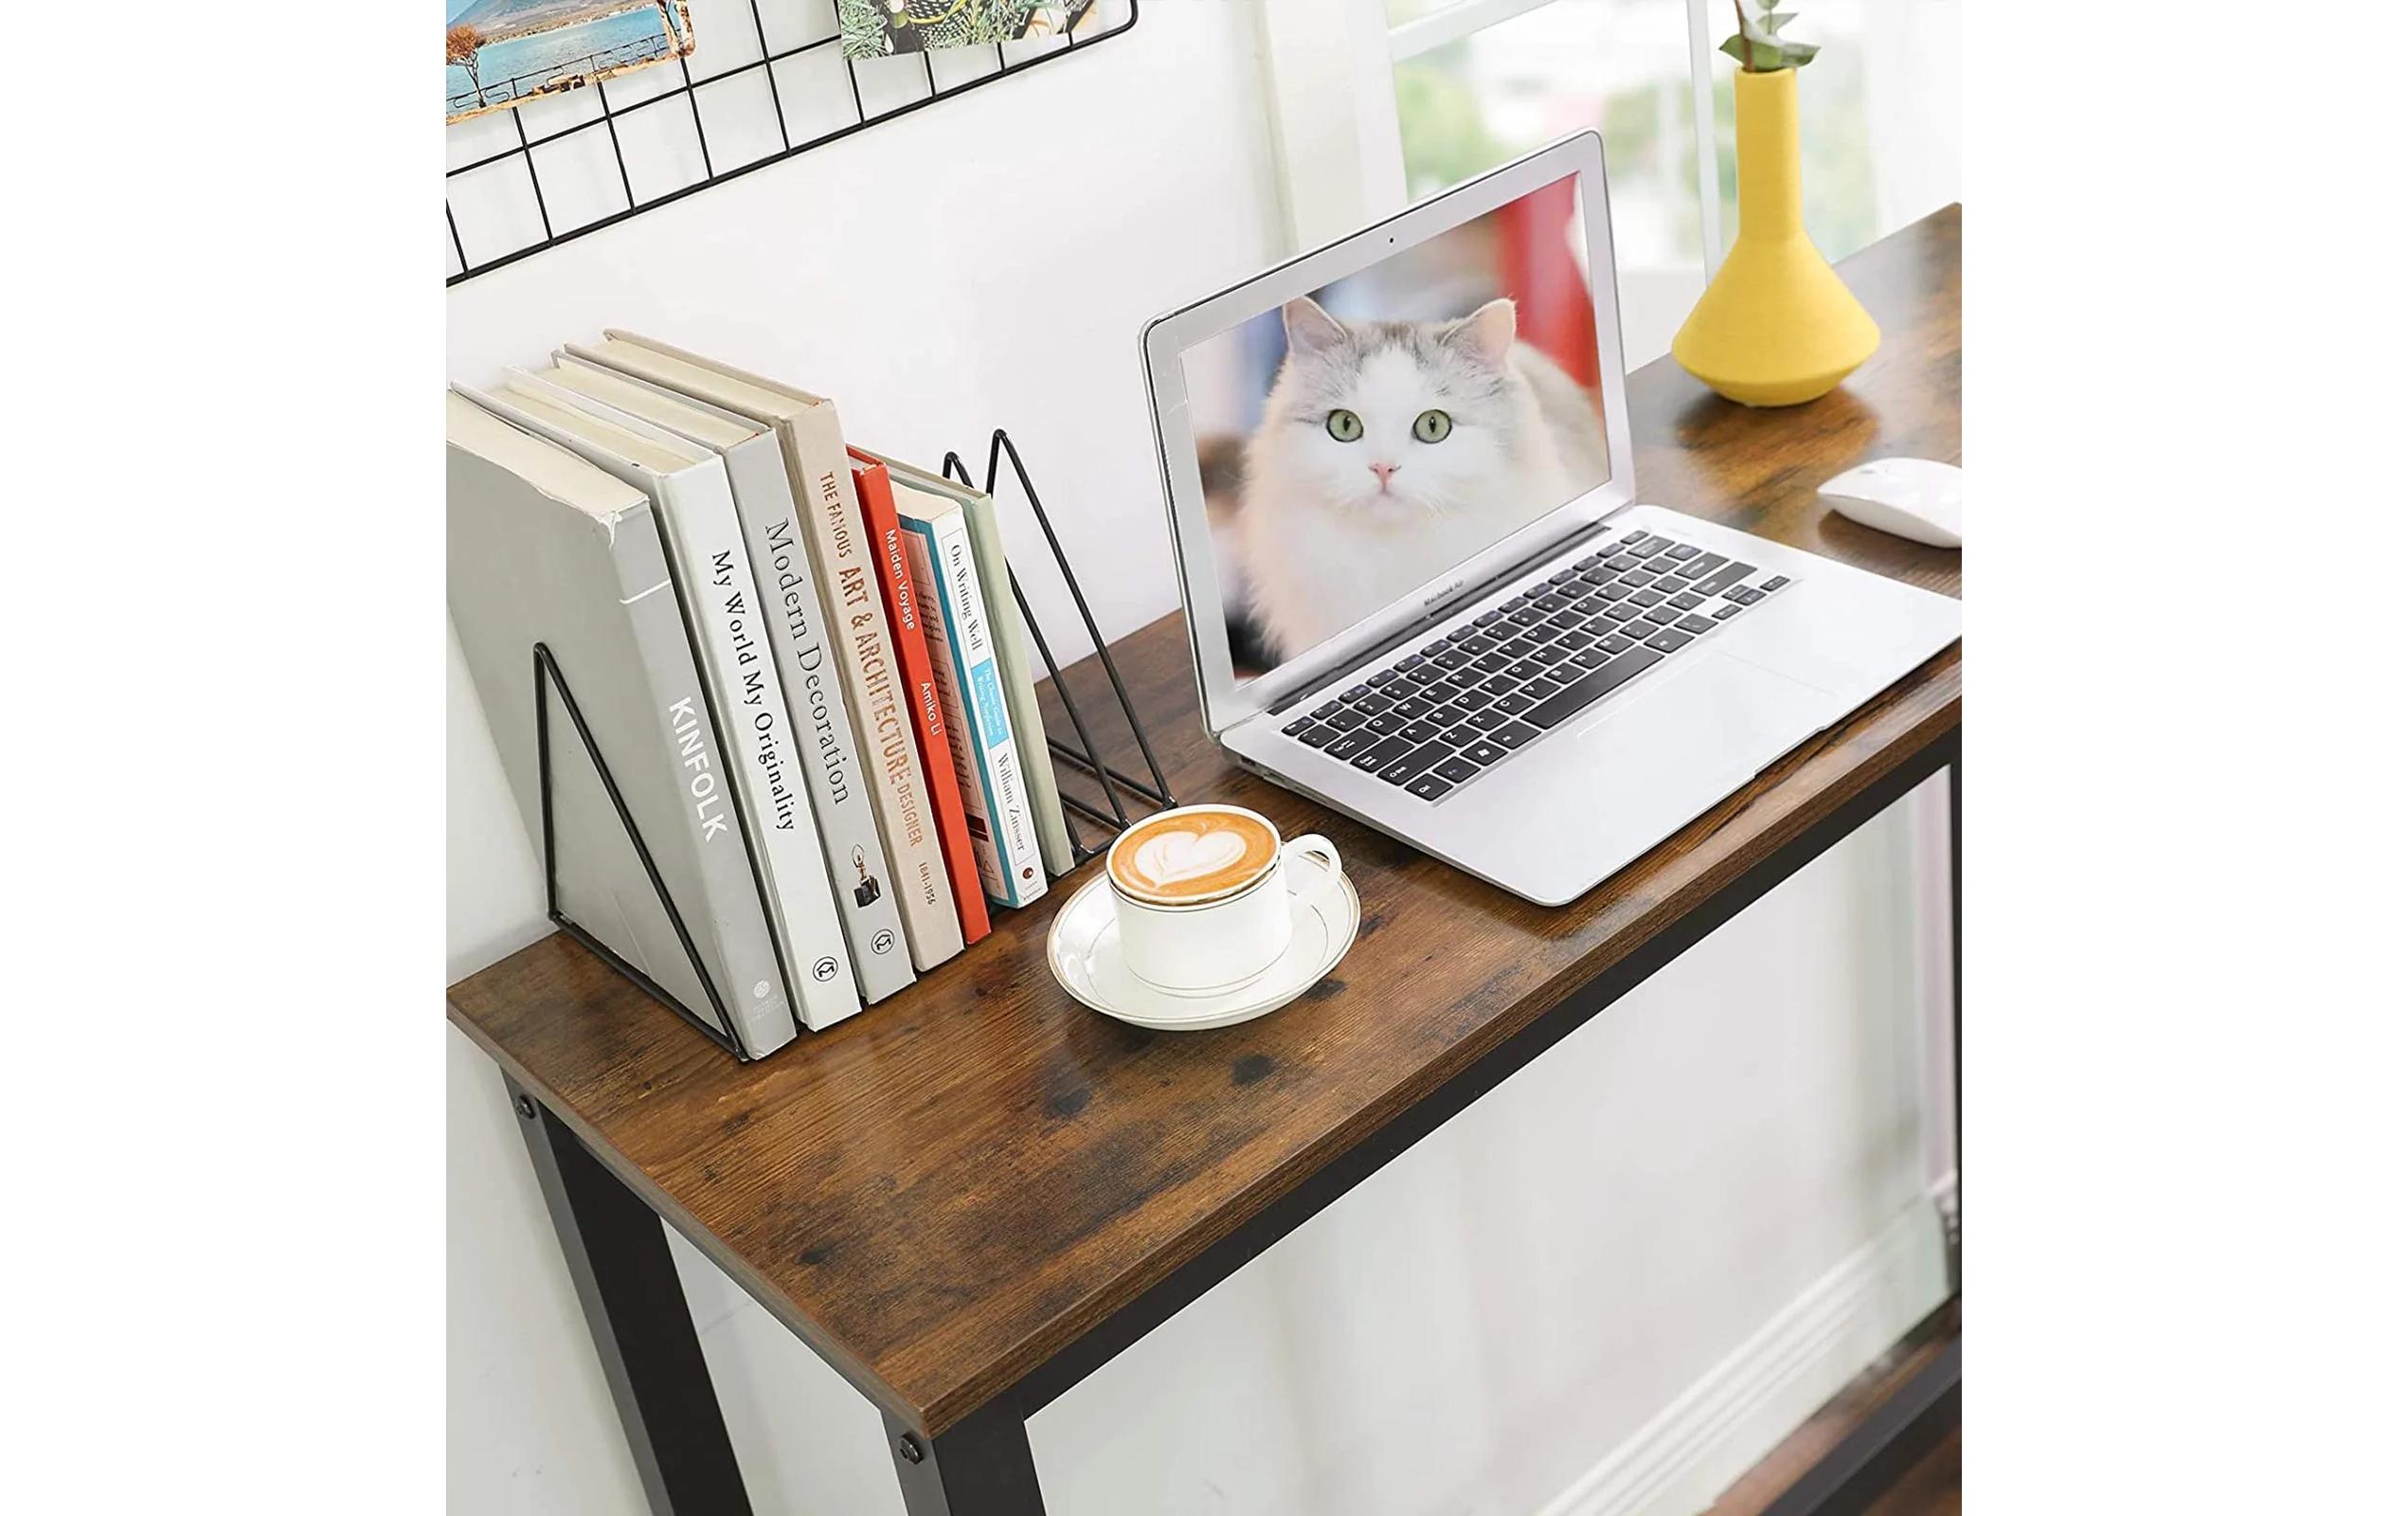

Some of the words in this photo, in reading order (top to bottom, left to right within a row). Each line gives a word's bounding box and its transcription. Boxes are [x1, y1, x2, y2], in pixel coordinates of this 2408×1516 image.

[820, 472, 838, 501] THE
[827, 503, 853, 558] FAMOUS
[838, 566, 870, 607] ART
[851, 612, 873, 630] &
[886, 529, 903, 579] Maiden
[898, 580, 915, 630] Voyage
[950, 544, 961, 567] On
[957, 568, 973, 621] Writing
[968, 619, 983, 651] Well
[712, 550, 732, 587] My
[725, 591, 757, 665] World
[743, 672, 764, 706] My
[754, 712, 796, 831] Originality
[764, 517, 807, 640] Modern
[798, 642, 850, 805] Decoration
[855, 631, 911, 785] ARCHITECTURE
[921, 682, 937, 721] Amiko
[930, 720, 942, 735] Li
[669, 696, 728, 841] KINFOLK
[897, 785, 923, 846] DESIGNER
[998, 752, 1014, 803] William
[1008, 804, 1025, 851] Zinsser
